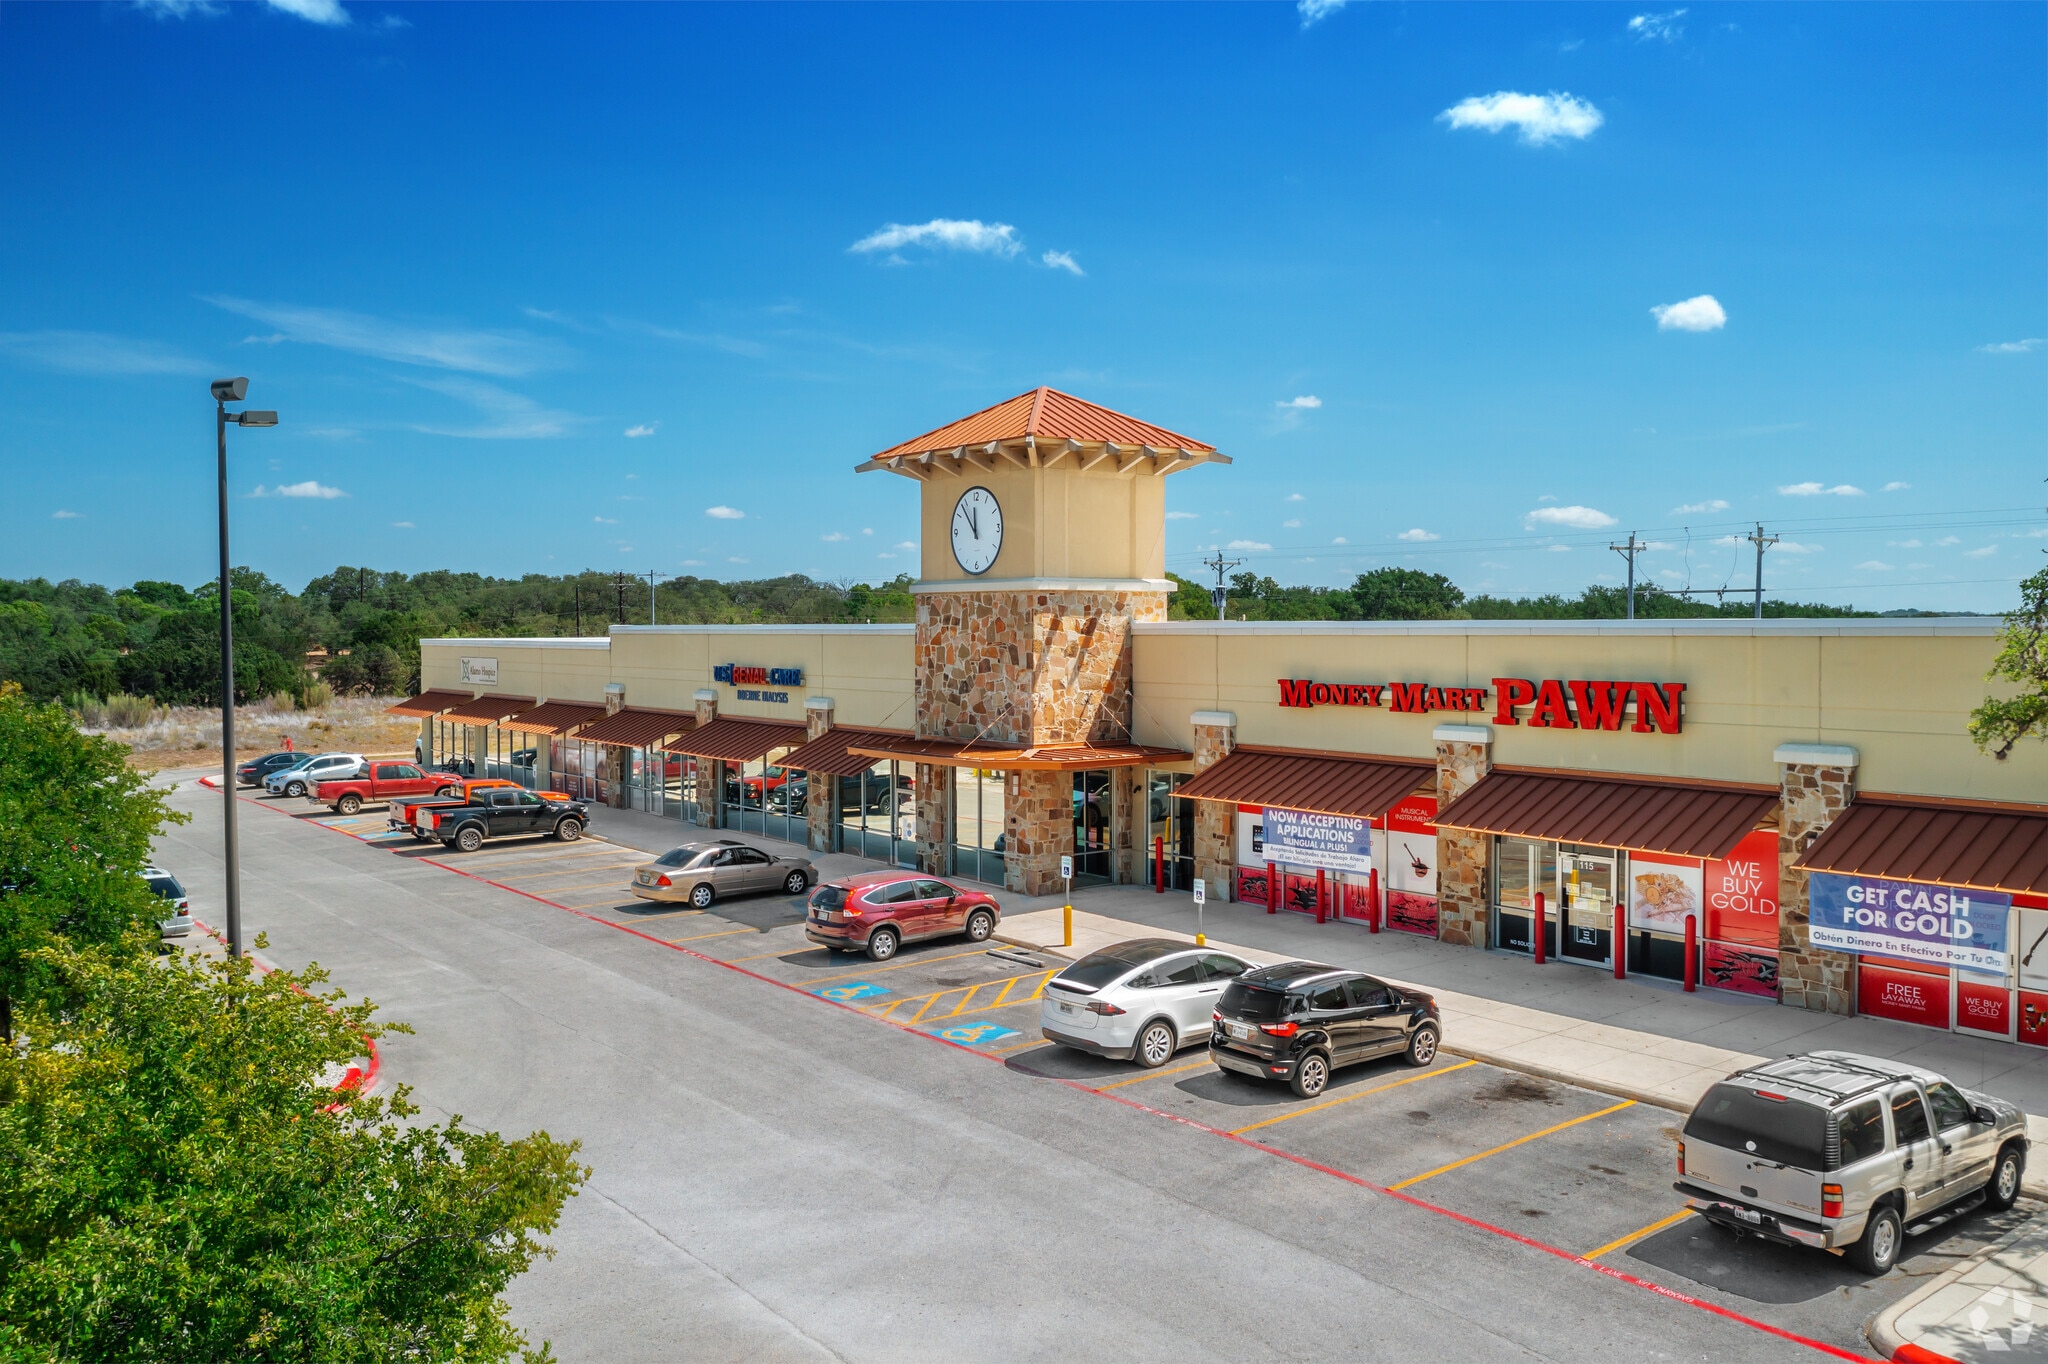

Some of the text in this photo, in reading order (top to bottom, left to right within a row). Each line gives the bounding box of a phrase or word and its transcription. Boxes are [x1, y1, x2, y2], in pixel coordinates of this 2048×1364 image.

[973, 492, 980, 501] 12
[953, 528, 959, 537] 9
[996, 523, 1001, 532] 3
[974, 561, 980, 570] 6
[732, 666, 768, 686] RENAL
[769, 667, 802, 687] CARE
[762, 691, 788, 704] DIALYSIS
[1491, 677, 1687, 735] PAWN
[1401, 807, 1428, 816] MUSICAL
[1268, 810, 1362, 831] NOW ACCEPTING
[1277, 824, 1354, 844] APPLICATIONS
[1283, 837, 1348, 852] BILINGUAL A PLUS!
[1327, 853, 1348, 861] Trabajo
[1580, 861, 1594, 871] 115
[1727, 860, 1760, 879] WE
[1723, 877, 1763, 896] BUY
[1711, 893, 1776, 915] GOLD
[1846, 885, 1889, 907] GET
[1895, 888, 1970, 918] CASH
[1843, 906, 1888, 929] FOR
[1894, 911, 1974, 940] GOLD
[1510, 938, 1517, 946] NO
[1813, 931, 1843, 944] Obtén
[1846, 935, 1883, 949] Dinero
[1885, 941, 1897, 951] En
[1900, 943, 1943, 958] Efectivo
[1946, 950, 1967, 961] Por
[1970, 952, 1983, 963] Tu
[1886, 982, 1921, 999] FREE
[1881, 992, 1927, 1007] LAYAWAY
[1965, 996, 2003, 1009] WE BUY
[1968, 1005, 1999, 1016] GOLD
[1573, 1257, 1593, 1268] FIRE
[1599, 1266, 1624, 1278] LANE
[1653, 1285, 1695, 1303] PARKING
